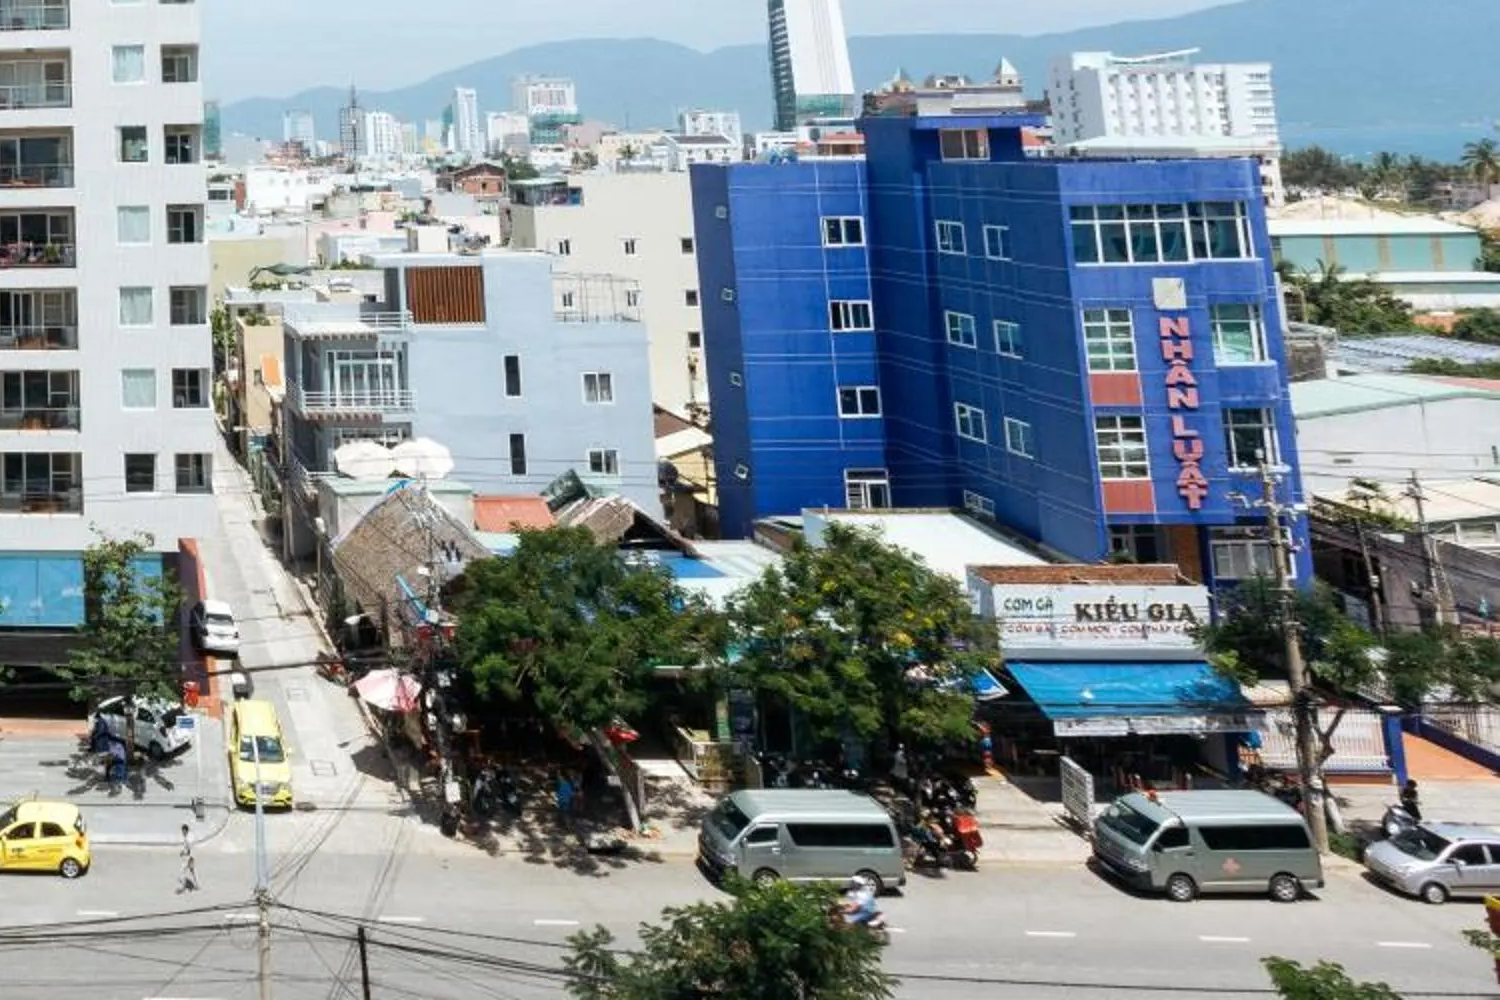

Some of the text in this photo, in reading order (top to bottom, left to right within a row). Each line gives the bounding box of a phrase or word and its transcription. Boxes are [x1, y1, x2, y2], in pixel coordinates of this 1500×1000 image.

[1159, 316, 1209, 510] NHÂN LUẬT
[1148, 603, 1197, 624] GIA
